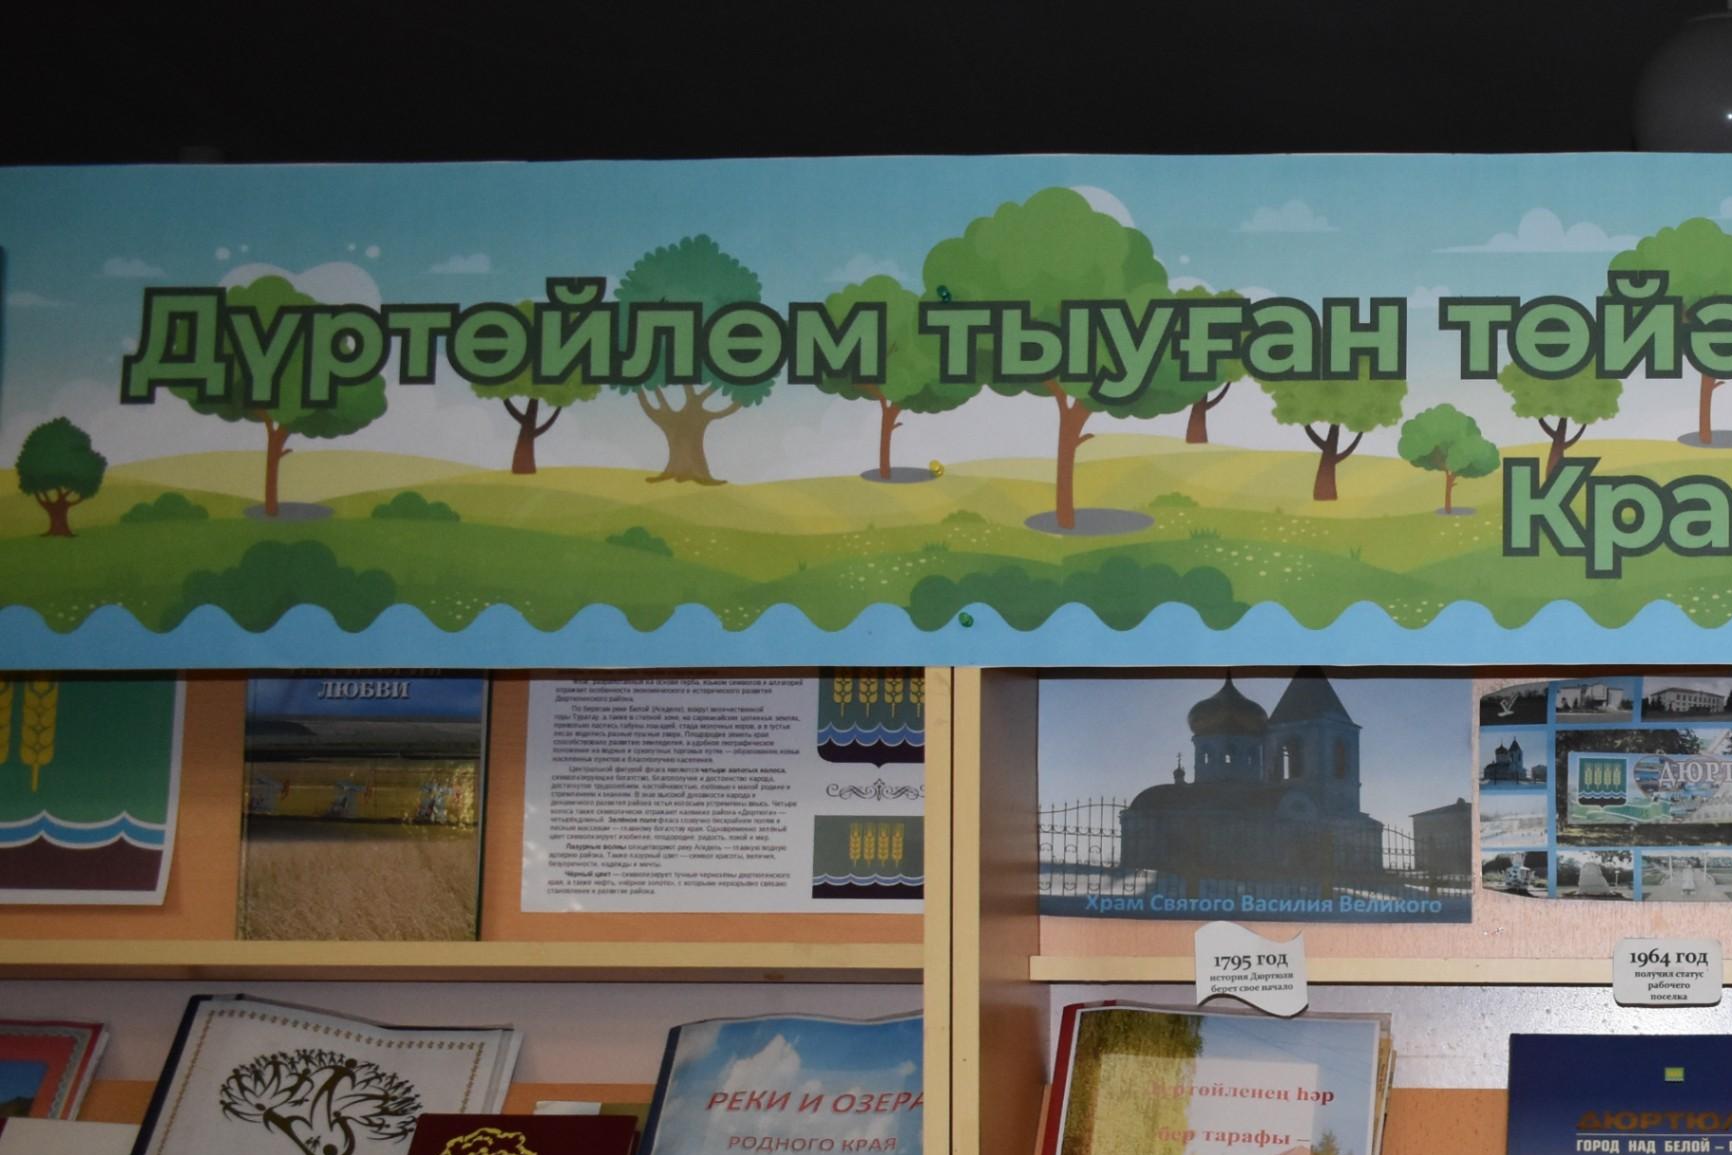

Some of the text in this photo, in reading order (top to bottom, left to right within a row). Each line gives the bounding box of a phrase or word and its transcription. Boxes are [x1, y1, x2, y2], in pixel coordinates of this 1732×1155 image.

[121, 276, 885, 404] Дүртөйлөм
[921, 295, 1407, 398] тыуған
[317, 680, 408, 700] ЛЮБВИ
[1086, 895, 1441, 914] Храм Святого Василия Великого
[1214, 953, 1288, 970] 1795 год
[1630, 948, 1708, 968] 1964 год
[1210, 972, 1293, 983] история Дюртюли
[1635, 971, 1704, 979] получил статус
[1211, 983, 1293, 994] берет свое начало
[1651, 993, 1687, 1001] поселка
[707, 1090, 792, 1113] РЕКИ
[799, 1093, 824, 1113] И
[1297, 1086, 1335, 1105] һәр
[727, 1136, 897, 1154] РОДНОГО КРАЯ
[1205, 1128, 1291, 1147] тарафы
[1576, 1139, 1620, 1153] ГОРОД
[1628, 1139, 1656, 1153] НАД
[1664, 1138, 1710, 1153] БЕЛОЙ
